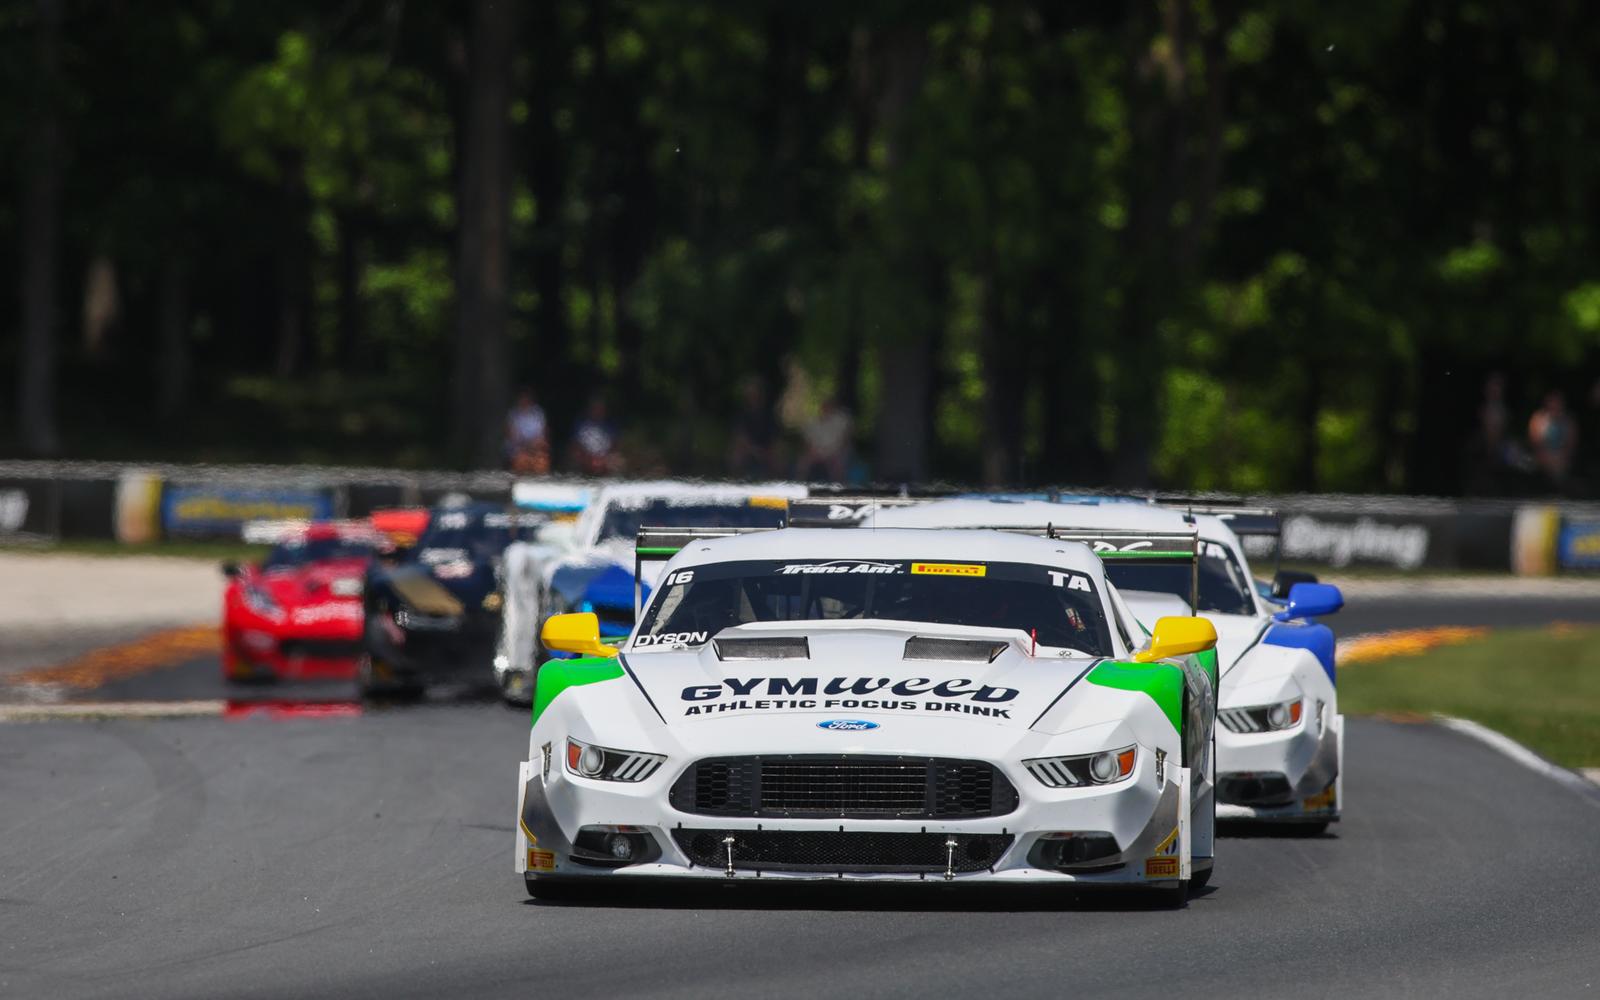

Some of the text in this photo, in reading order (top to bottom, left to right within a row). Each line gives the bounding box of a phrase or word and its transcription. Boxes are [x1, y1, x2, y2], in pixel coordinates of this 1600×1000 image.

[782, 564, 849, 575] Trans
[667, 571, 694, 586] 16
[1048, 571, 1091, 592] TA
[634, 632, 708, 646] DYSON
[685, 700, 1011, 719] ATHLETIC FOCUS DRINK
[828, 720, 868, 730] Ford
